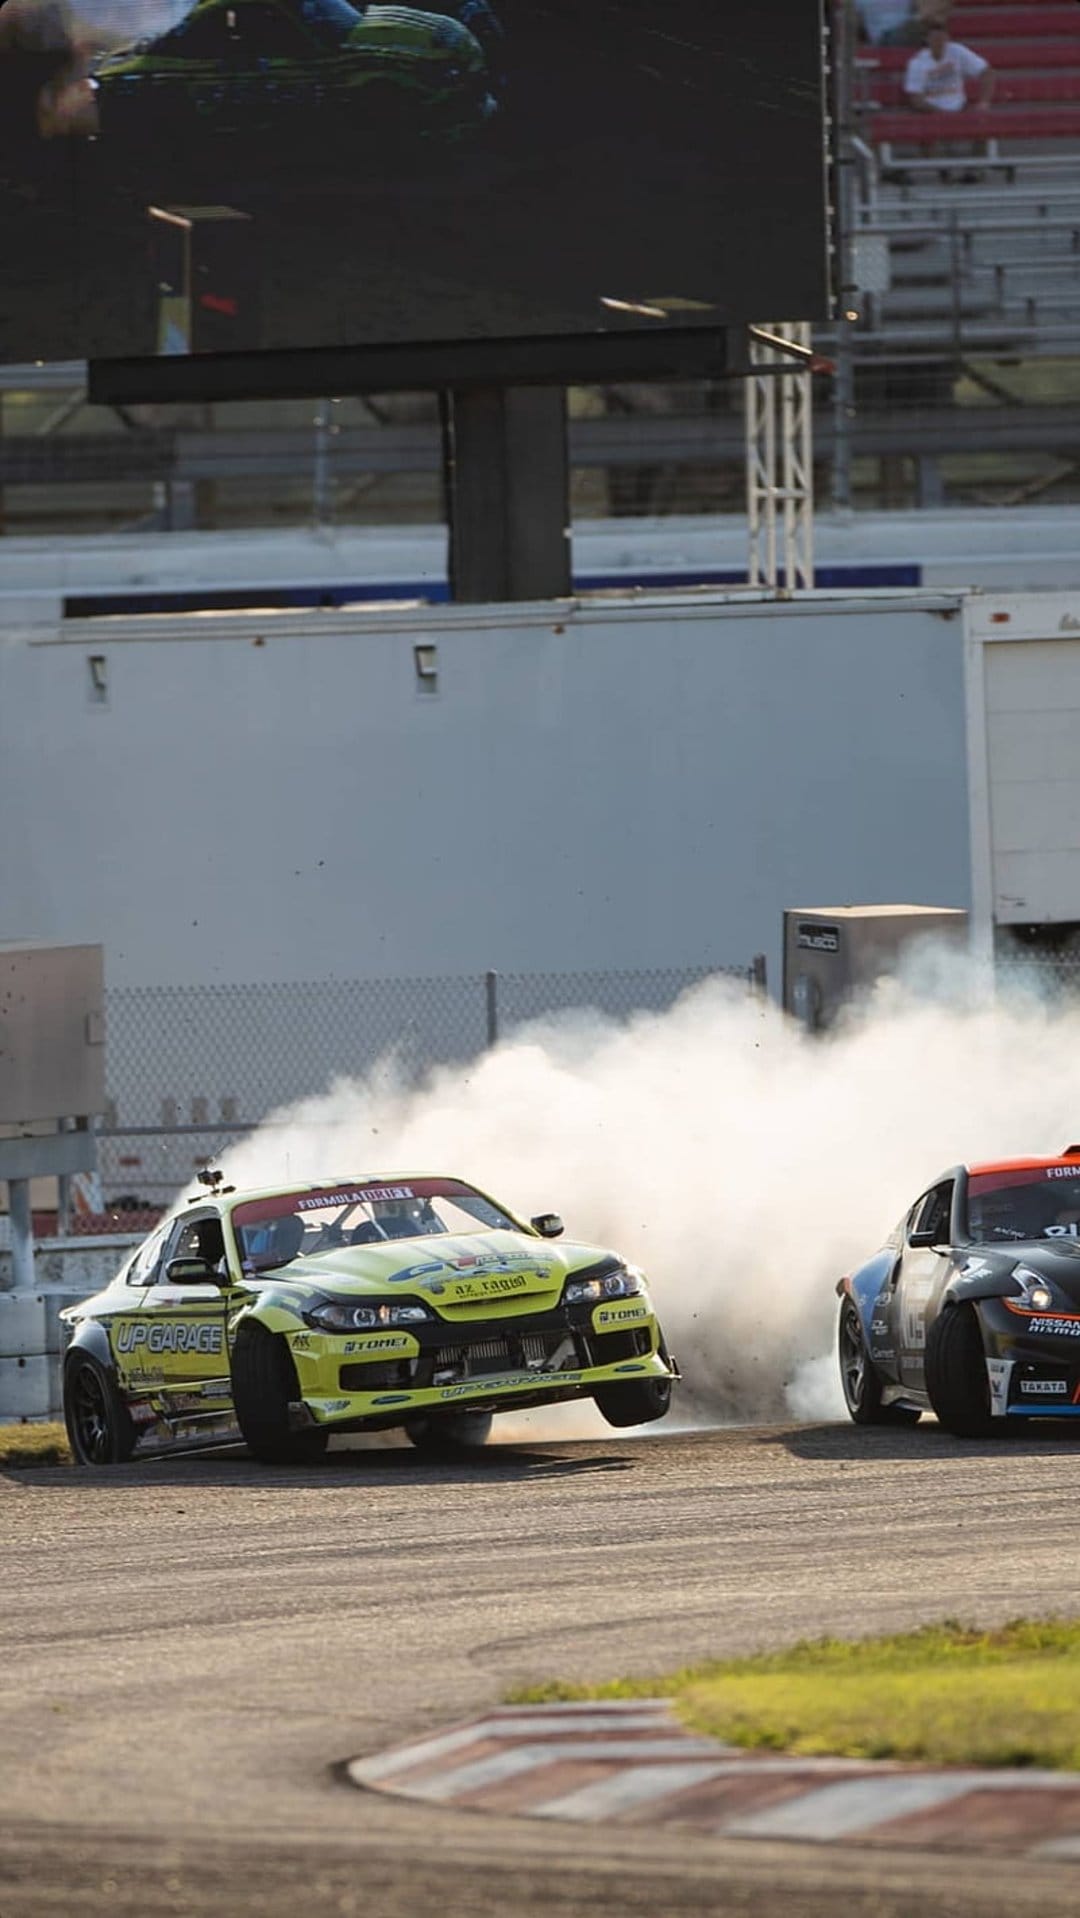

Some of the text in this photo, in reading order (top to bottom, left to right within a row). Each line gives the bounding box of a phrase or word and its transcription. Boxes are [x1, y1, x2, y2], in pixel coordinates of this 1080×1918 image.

[610, 1308, 647, 1321] TOMEI
[357, 1337, 408, 1351] TOMEI
[1022, 1381, 1066, 1392] TAKATA
